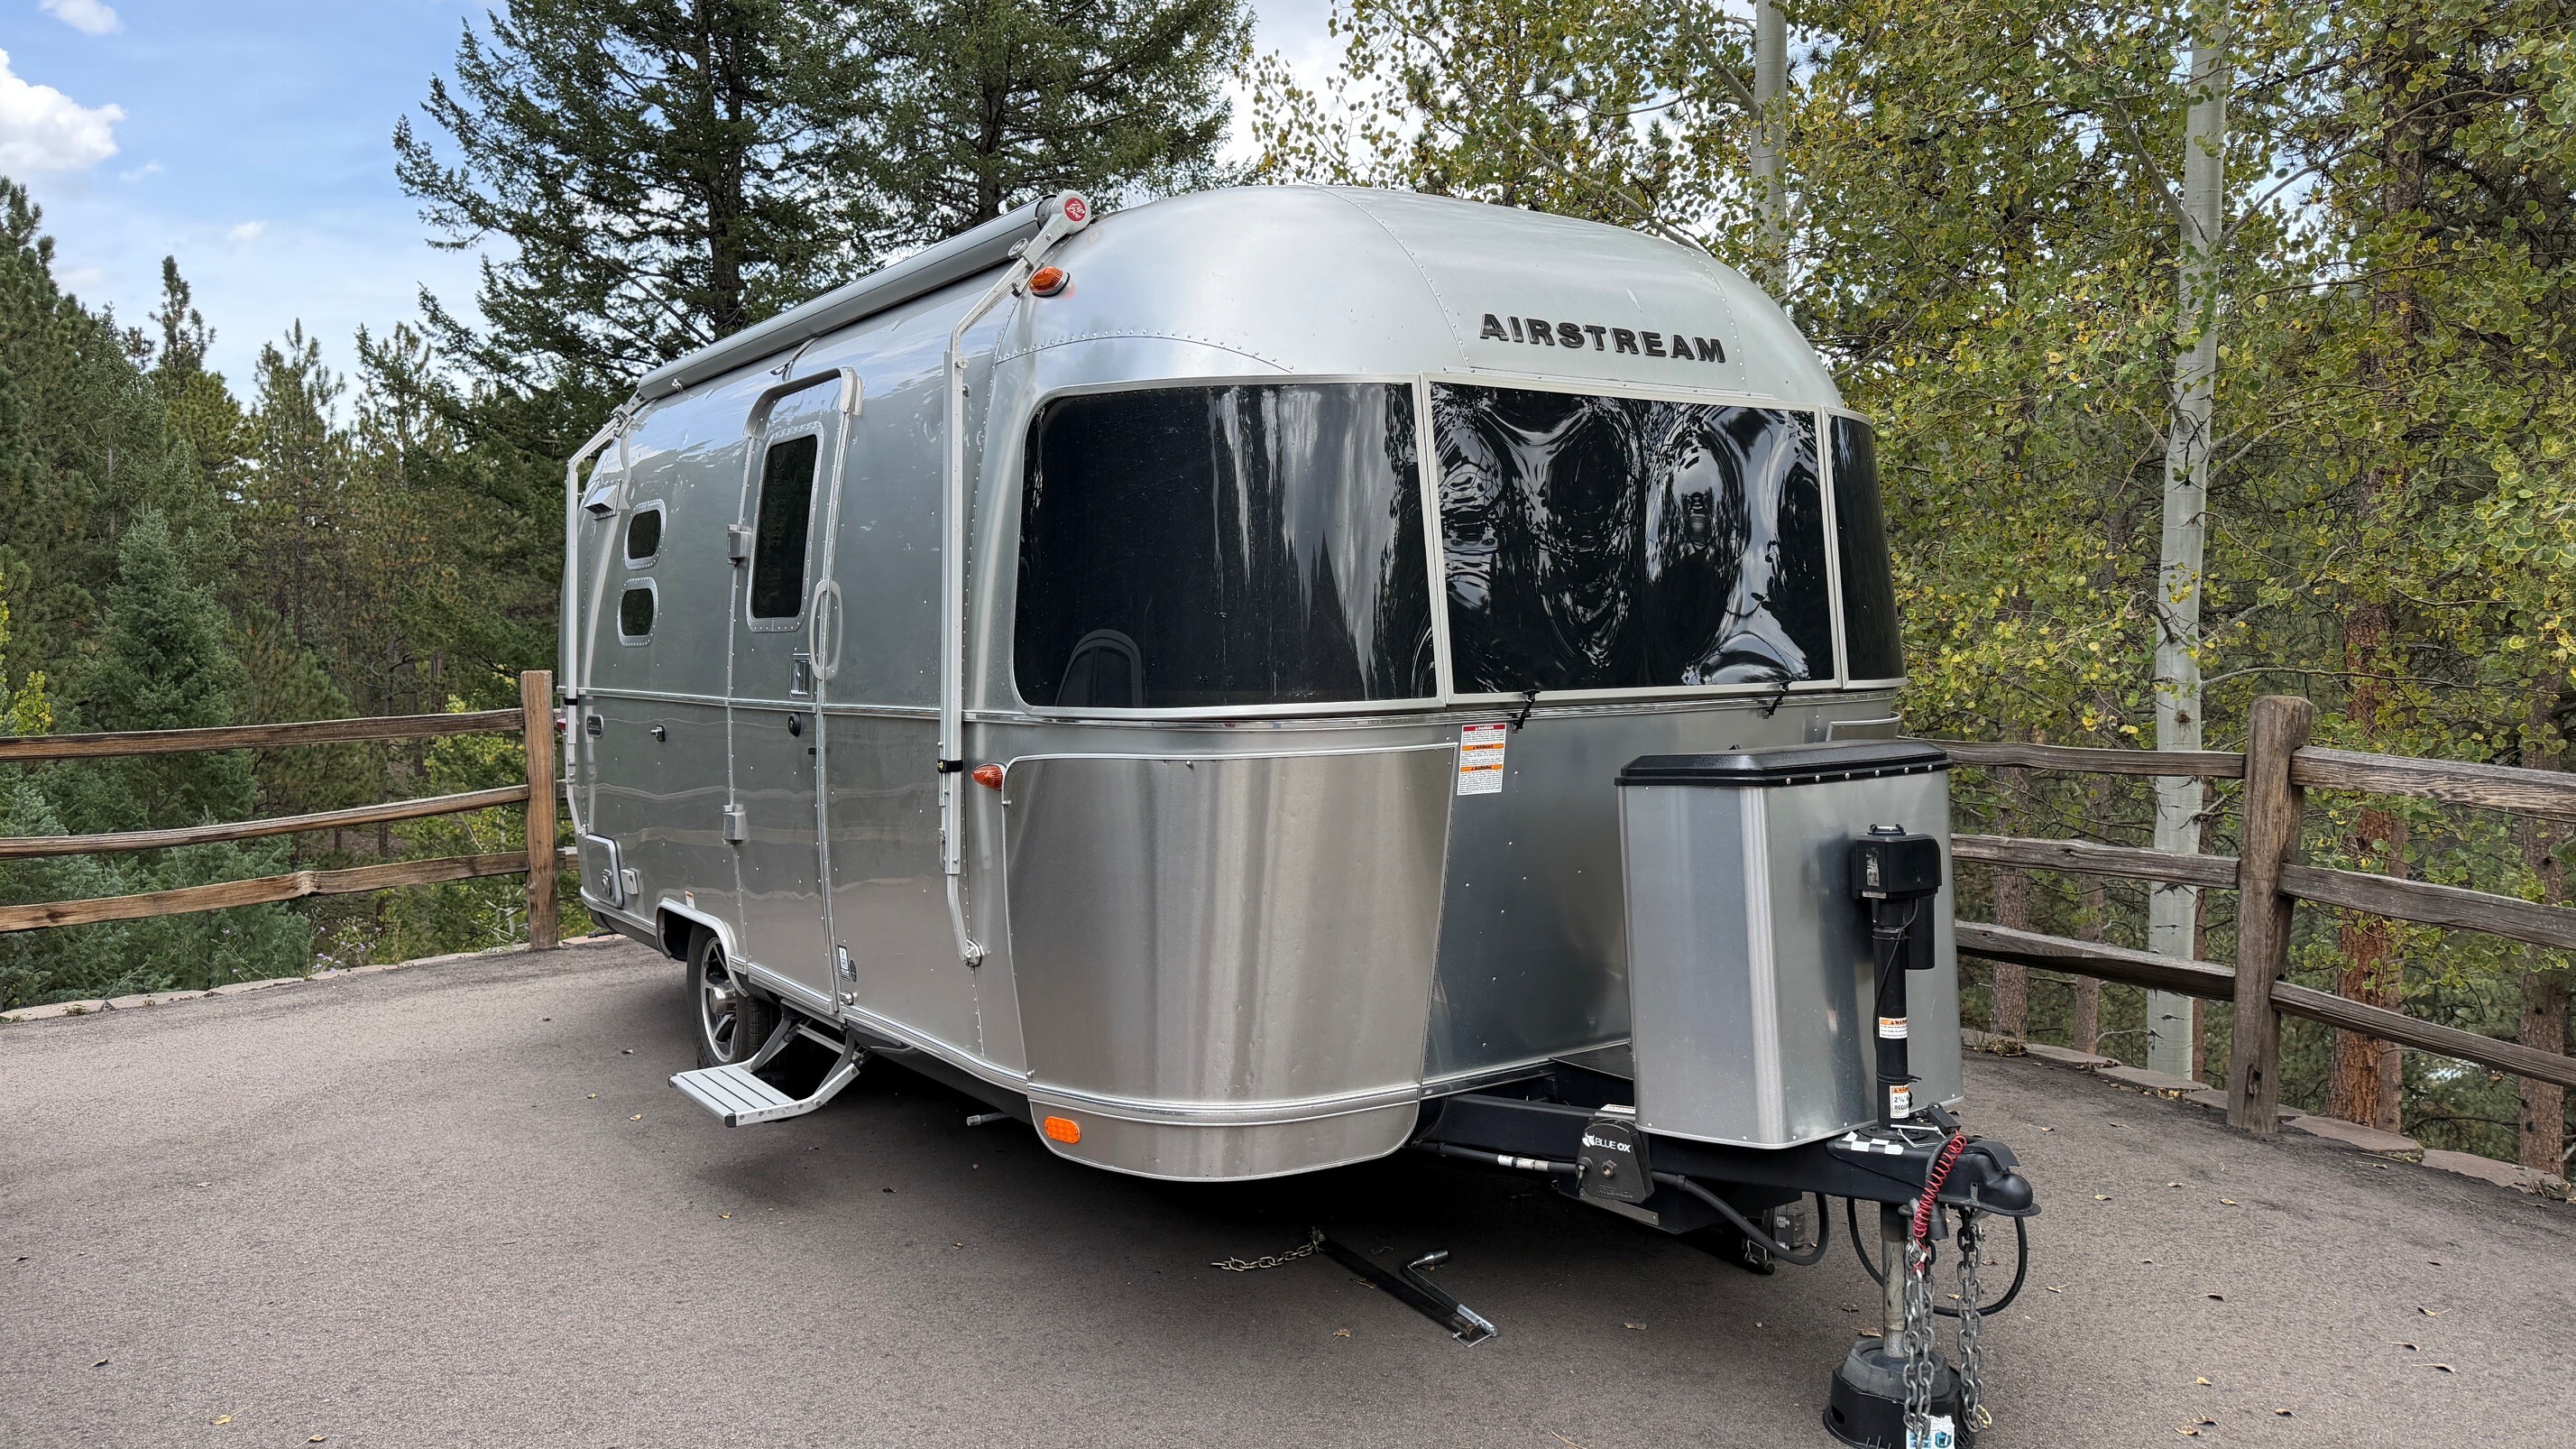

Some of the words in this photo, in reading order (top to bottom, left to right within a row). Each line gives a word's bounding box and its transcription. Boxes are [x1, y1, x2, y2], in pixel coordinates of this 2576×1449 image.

[1480, 313, 1725, 363] AIRSTREAM
[1596, 1137, 1616, 1149] BLUE
[1617, 1142, 1631, 1153] OX
